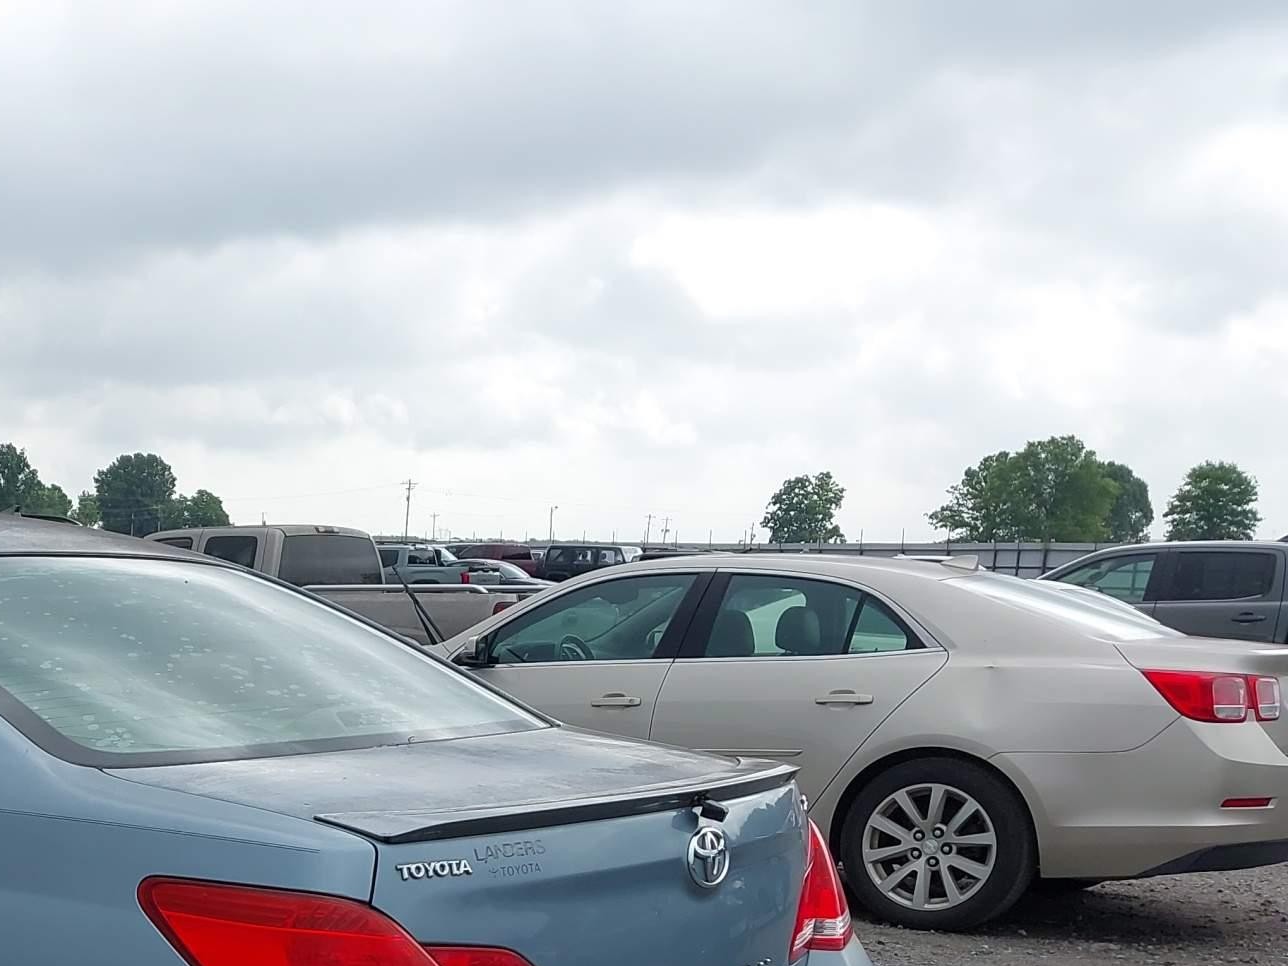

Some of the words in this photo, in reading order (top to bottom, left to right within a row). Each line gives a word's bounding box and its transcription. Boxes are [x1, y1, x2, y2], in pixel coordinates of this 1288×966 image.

[473, 840, 546, 864] LANDERS
[396, 859, 473, 881] TOYOTA
[500, 863, 542, 877] TOYOTA
